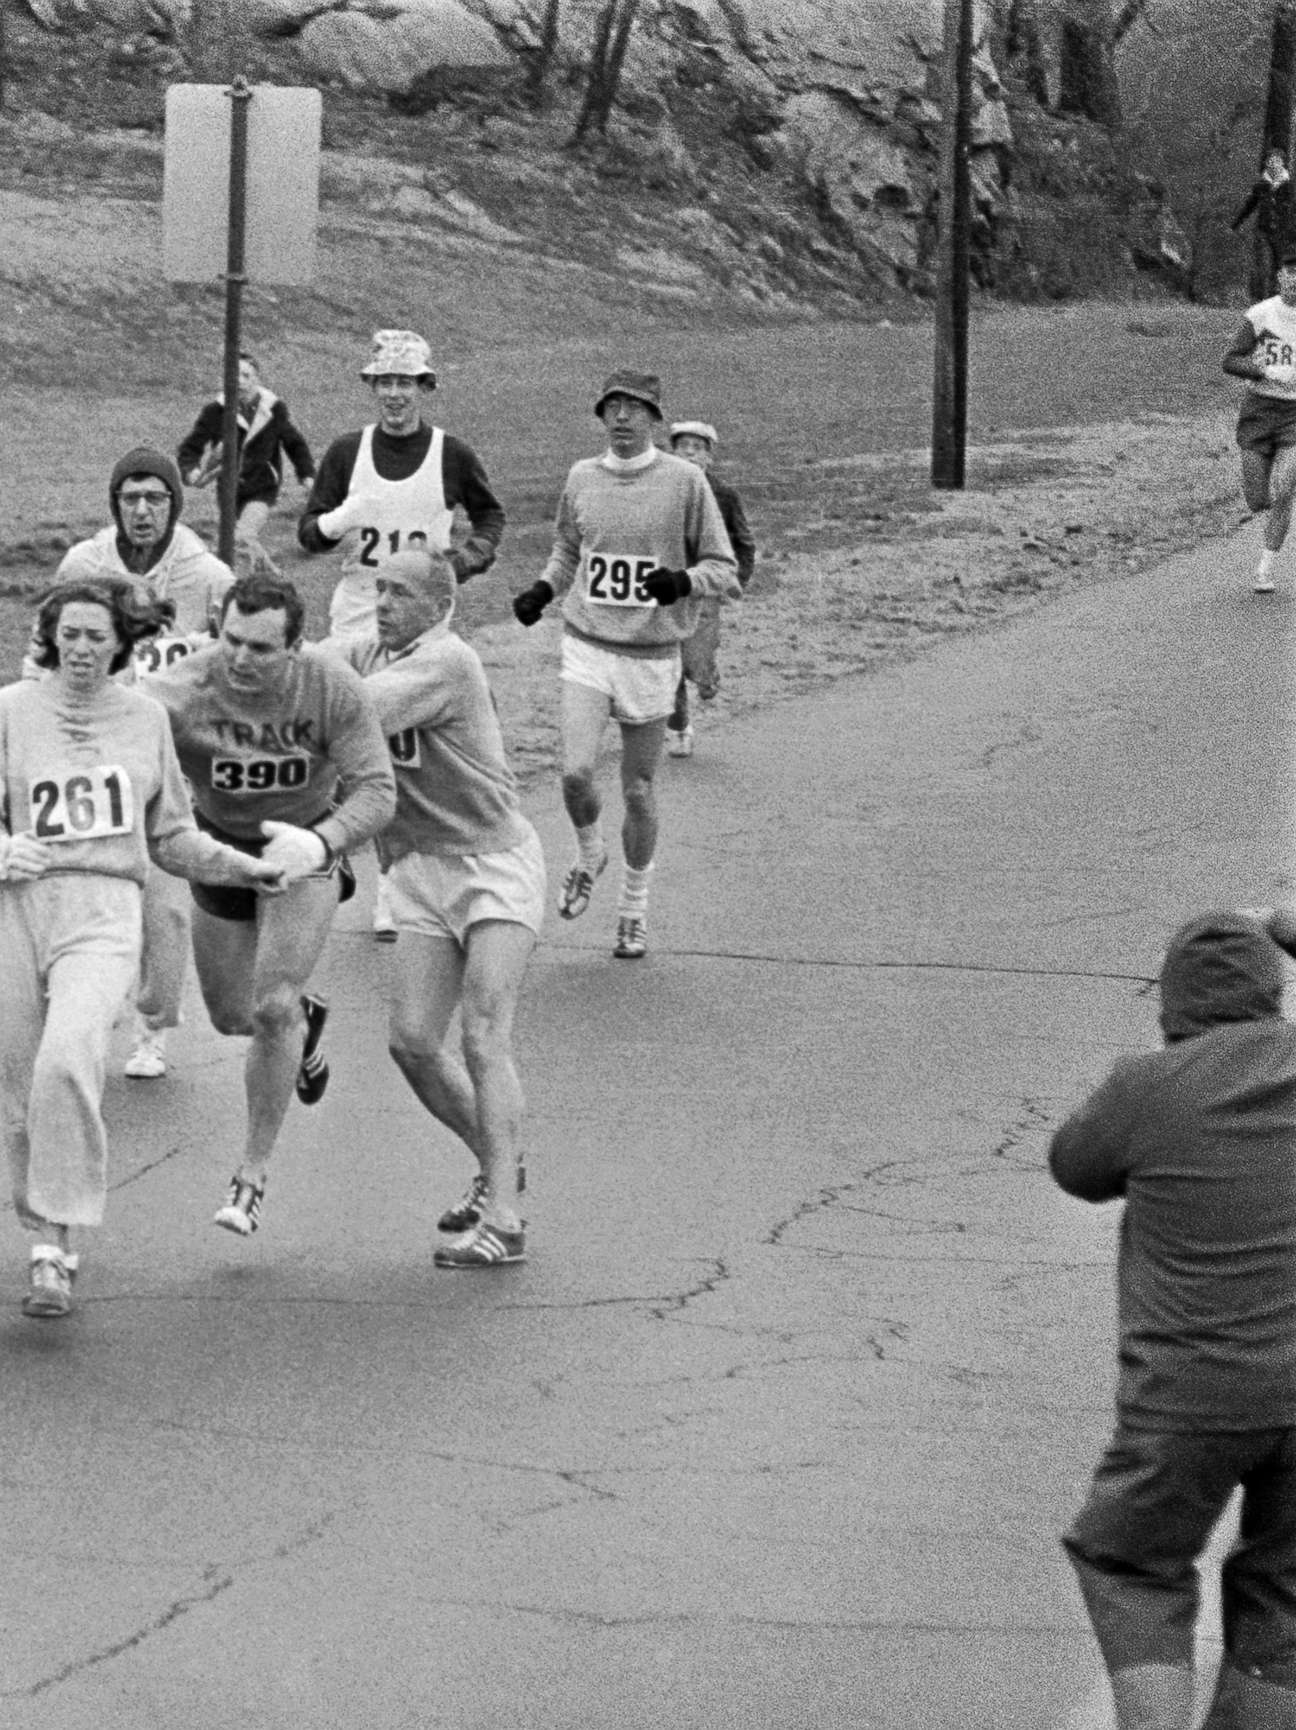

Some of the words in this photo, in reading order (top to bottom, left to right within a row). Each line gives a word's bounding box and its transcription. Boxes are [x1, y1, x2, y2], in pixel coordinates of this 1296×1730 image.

[589, 556, 655, 602] 295
[208, 718, 315, 752] TRACK
[214, 758, 307, 791] 390
[31, 771, 124, 838] 261
